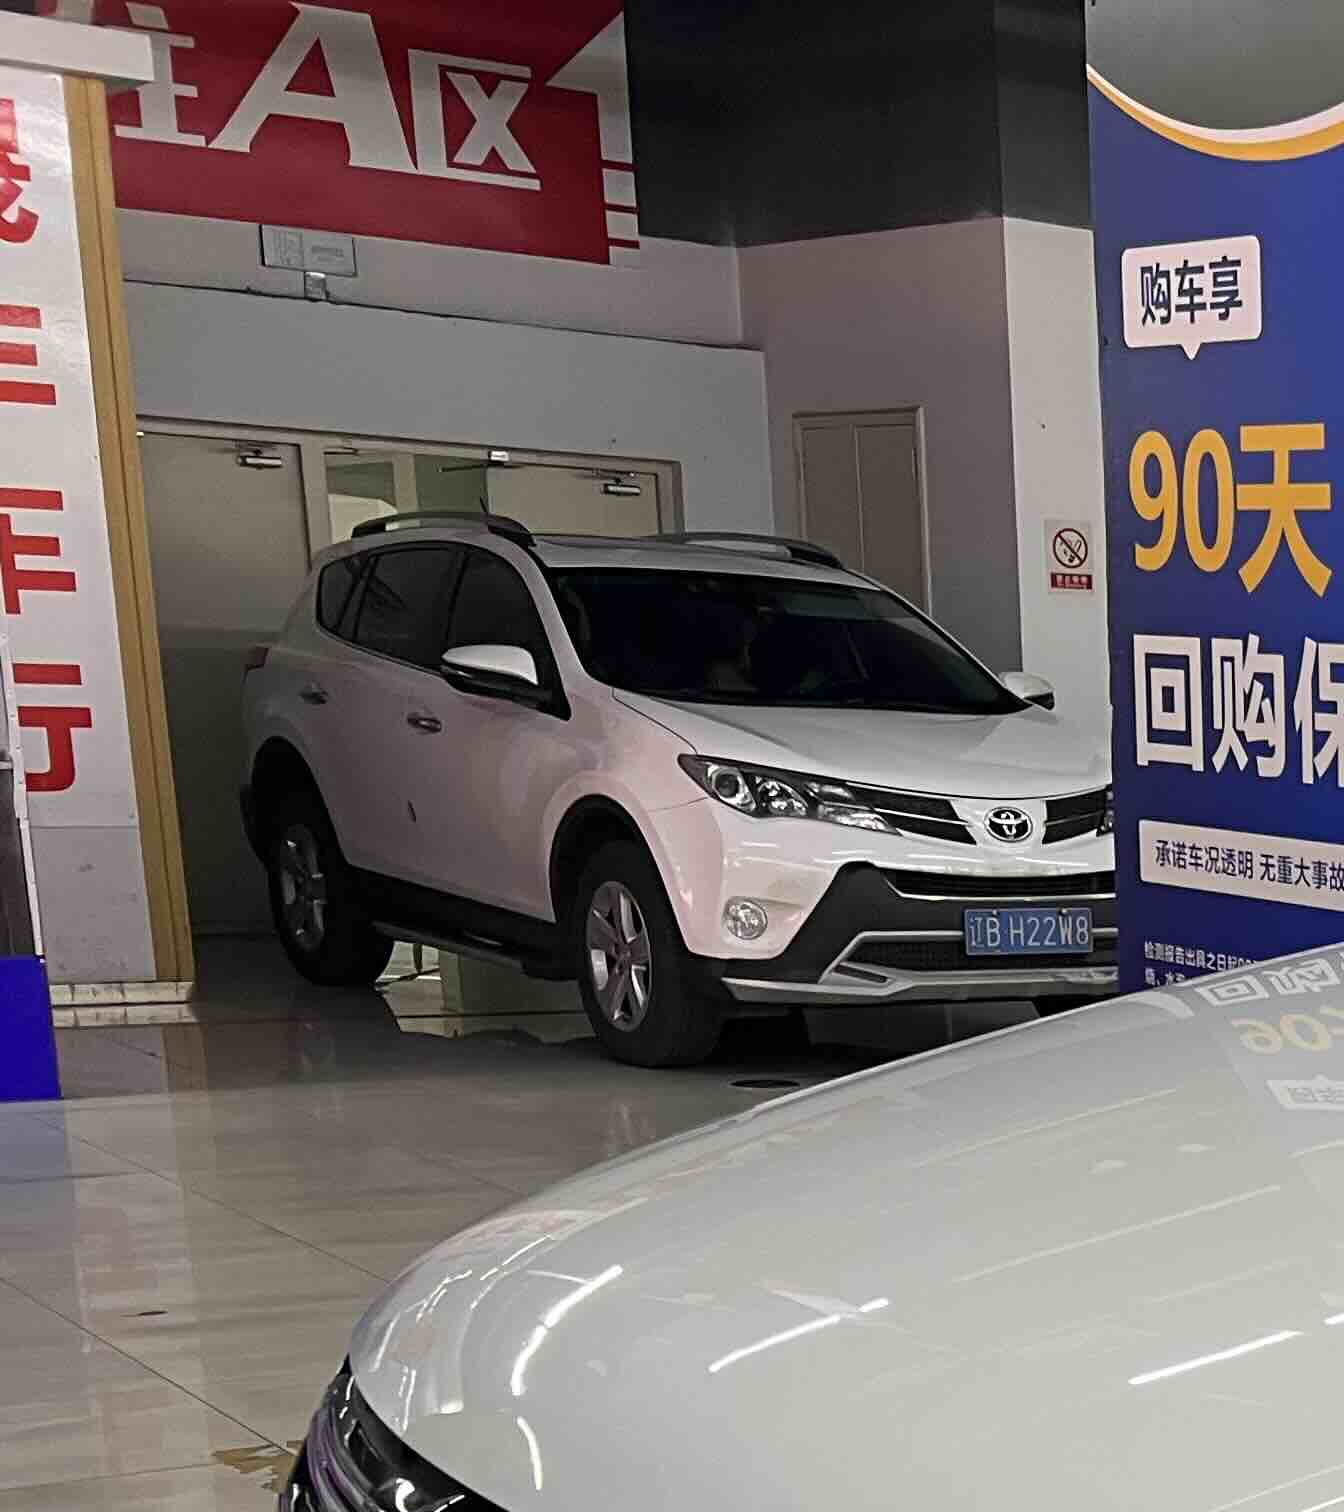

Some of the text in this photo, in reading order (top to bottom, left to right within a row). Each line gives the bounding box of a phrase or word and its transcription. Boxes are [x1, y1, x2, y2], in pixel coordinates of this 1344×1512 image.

[1139, 255, 1243, 327] 购车享
[1128, 422, 1333, 597] 90天
[1155, 838, 1254, 881] 承诺车况透明
